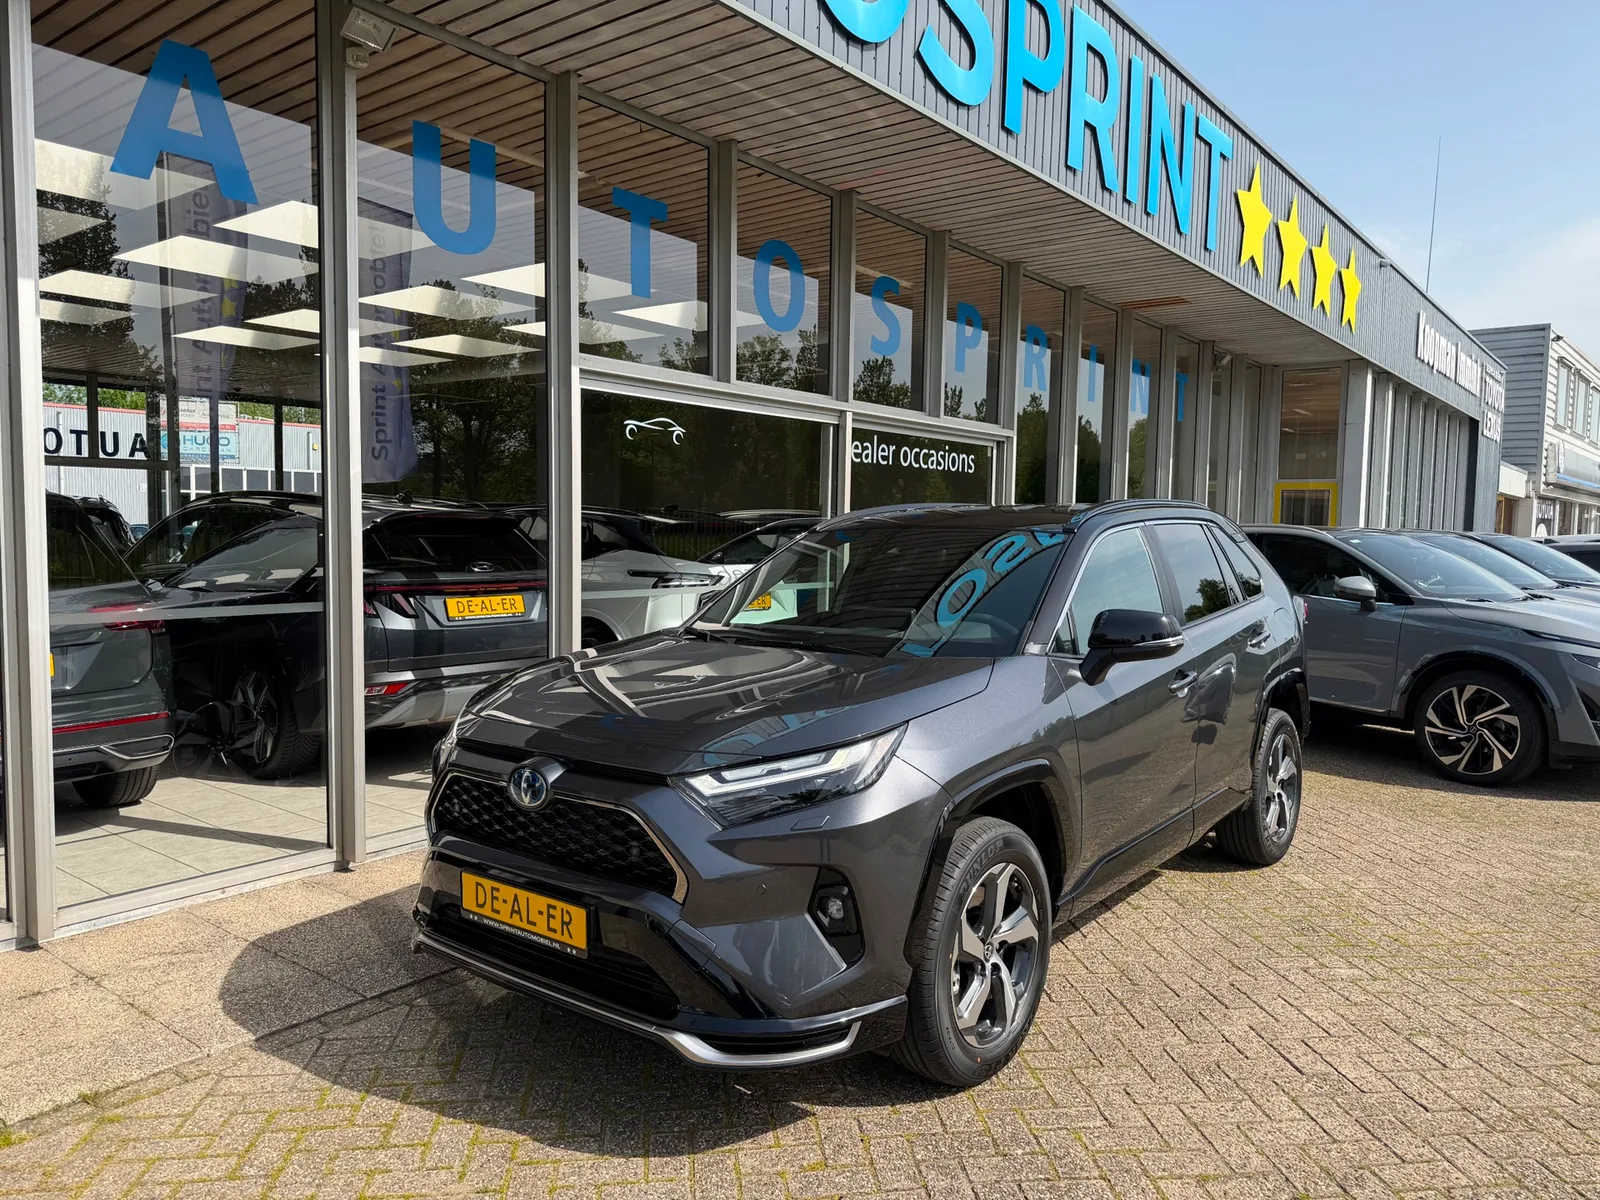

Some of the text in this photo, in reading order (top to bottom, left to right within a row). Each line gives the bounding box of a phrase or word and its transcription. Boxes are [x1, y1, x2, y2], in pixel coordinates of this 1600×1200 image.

[821, 0, 1233, 252] SPRINT
[1416, 309, 1456, 382] Koopman
[851, 434, 975, 474] ealer occasions
[456, 597, 518, 614] DE-AL-ER
[475, 881, 574, 940] DE-AL-ER
[482, 917, 561, 950] WWW.SPRINTAUTOMOBIEL.NL
